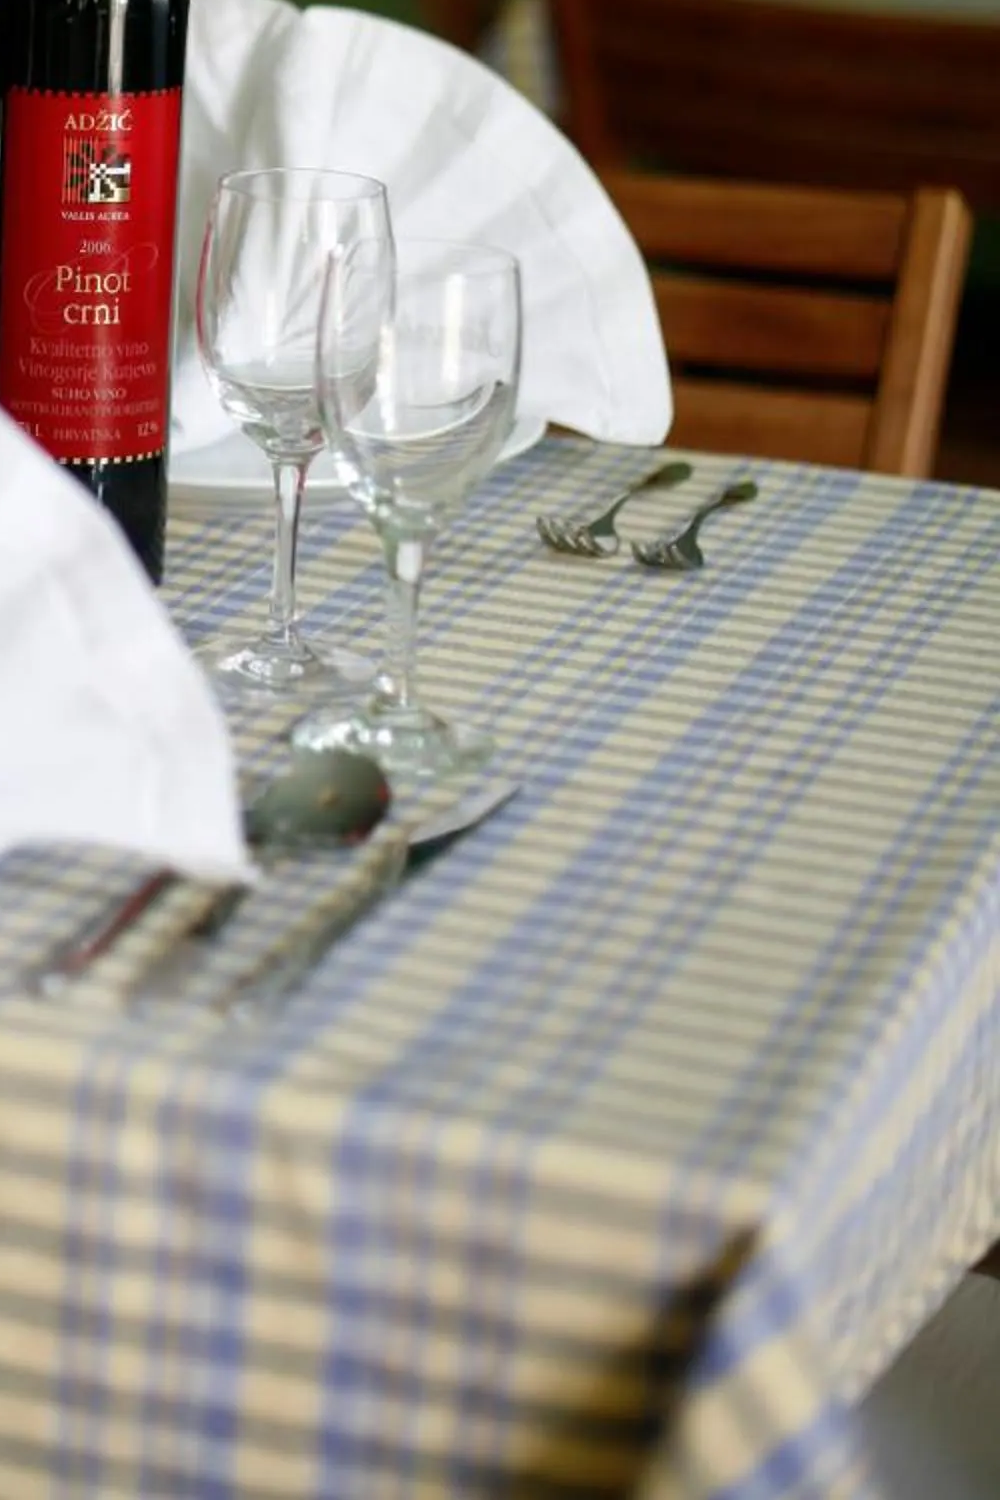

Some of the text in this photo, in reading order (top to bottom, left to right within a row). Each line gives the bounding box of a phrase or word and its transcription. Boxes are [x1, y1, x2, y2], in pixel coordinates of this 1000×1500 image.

[64, 108, 133, 131] ADŽIĆ
[61, 211, 95, 221] VALLIS
[55, 265, 132, 294] Pinot
[63, 298, 121, 325] crni
